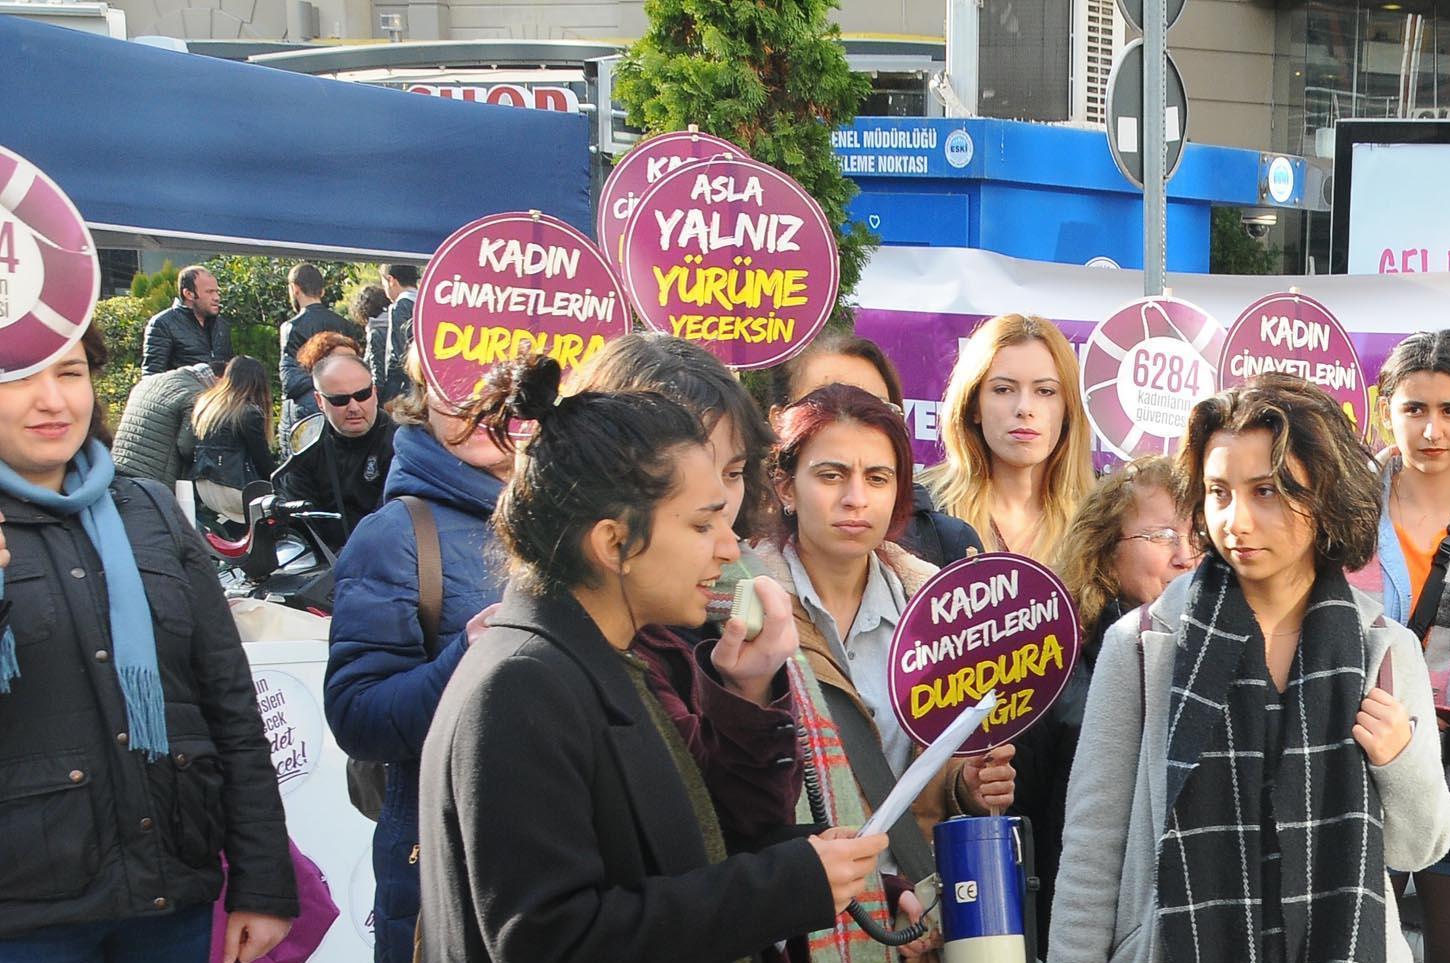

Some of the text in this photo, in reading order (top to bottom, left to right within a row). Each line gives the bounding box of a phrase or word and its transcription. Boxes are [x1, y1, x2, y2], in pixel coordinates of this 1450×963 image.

[830, 127, 937, 149] ENEL MÜDÜRLÜĞÜ
[878, 155, 928, 174] NOKTASI
[691, 173, 764, 206] ASLA
[654, 208, 805, 255] YALNIZ
[478, 237, 581, 280] KADIN
[434, 274, 616, 323] CİNAYETLERİNİ
[652, 254, 809, 311] YÜRÜME
[668, 311, 796, 344] YECEKSİN
[1260, 314, 1331, 352] KADIN
[1132, 348, 1200, 397] 6284
[1136, 407, 1186, 428] güvences
[930, 569, 1019, 625] KADIN
[901, 591, 1060, 674] CİNAYETLERİNİ
[910, 634, 1065, 720] DURDURA
[982, 688, 1035, 733] ĞIZ
